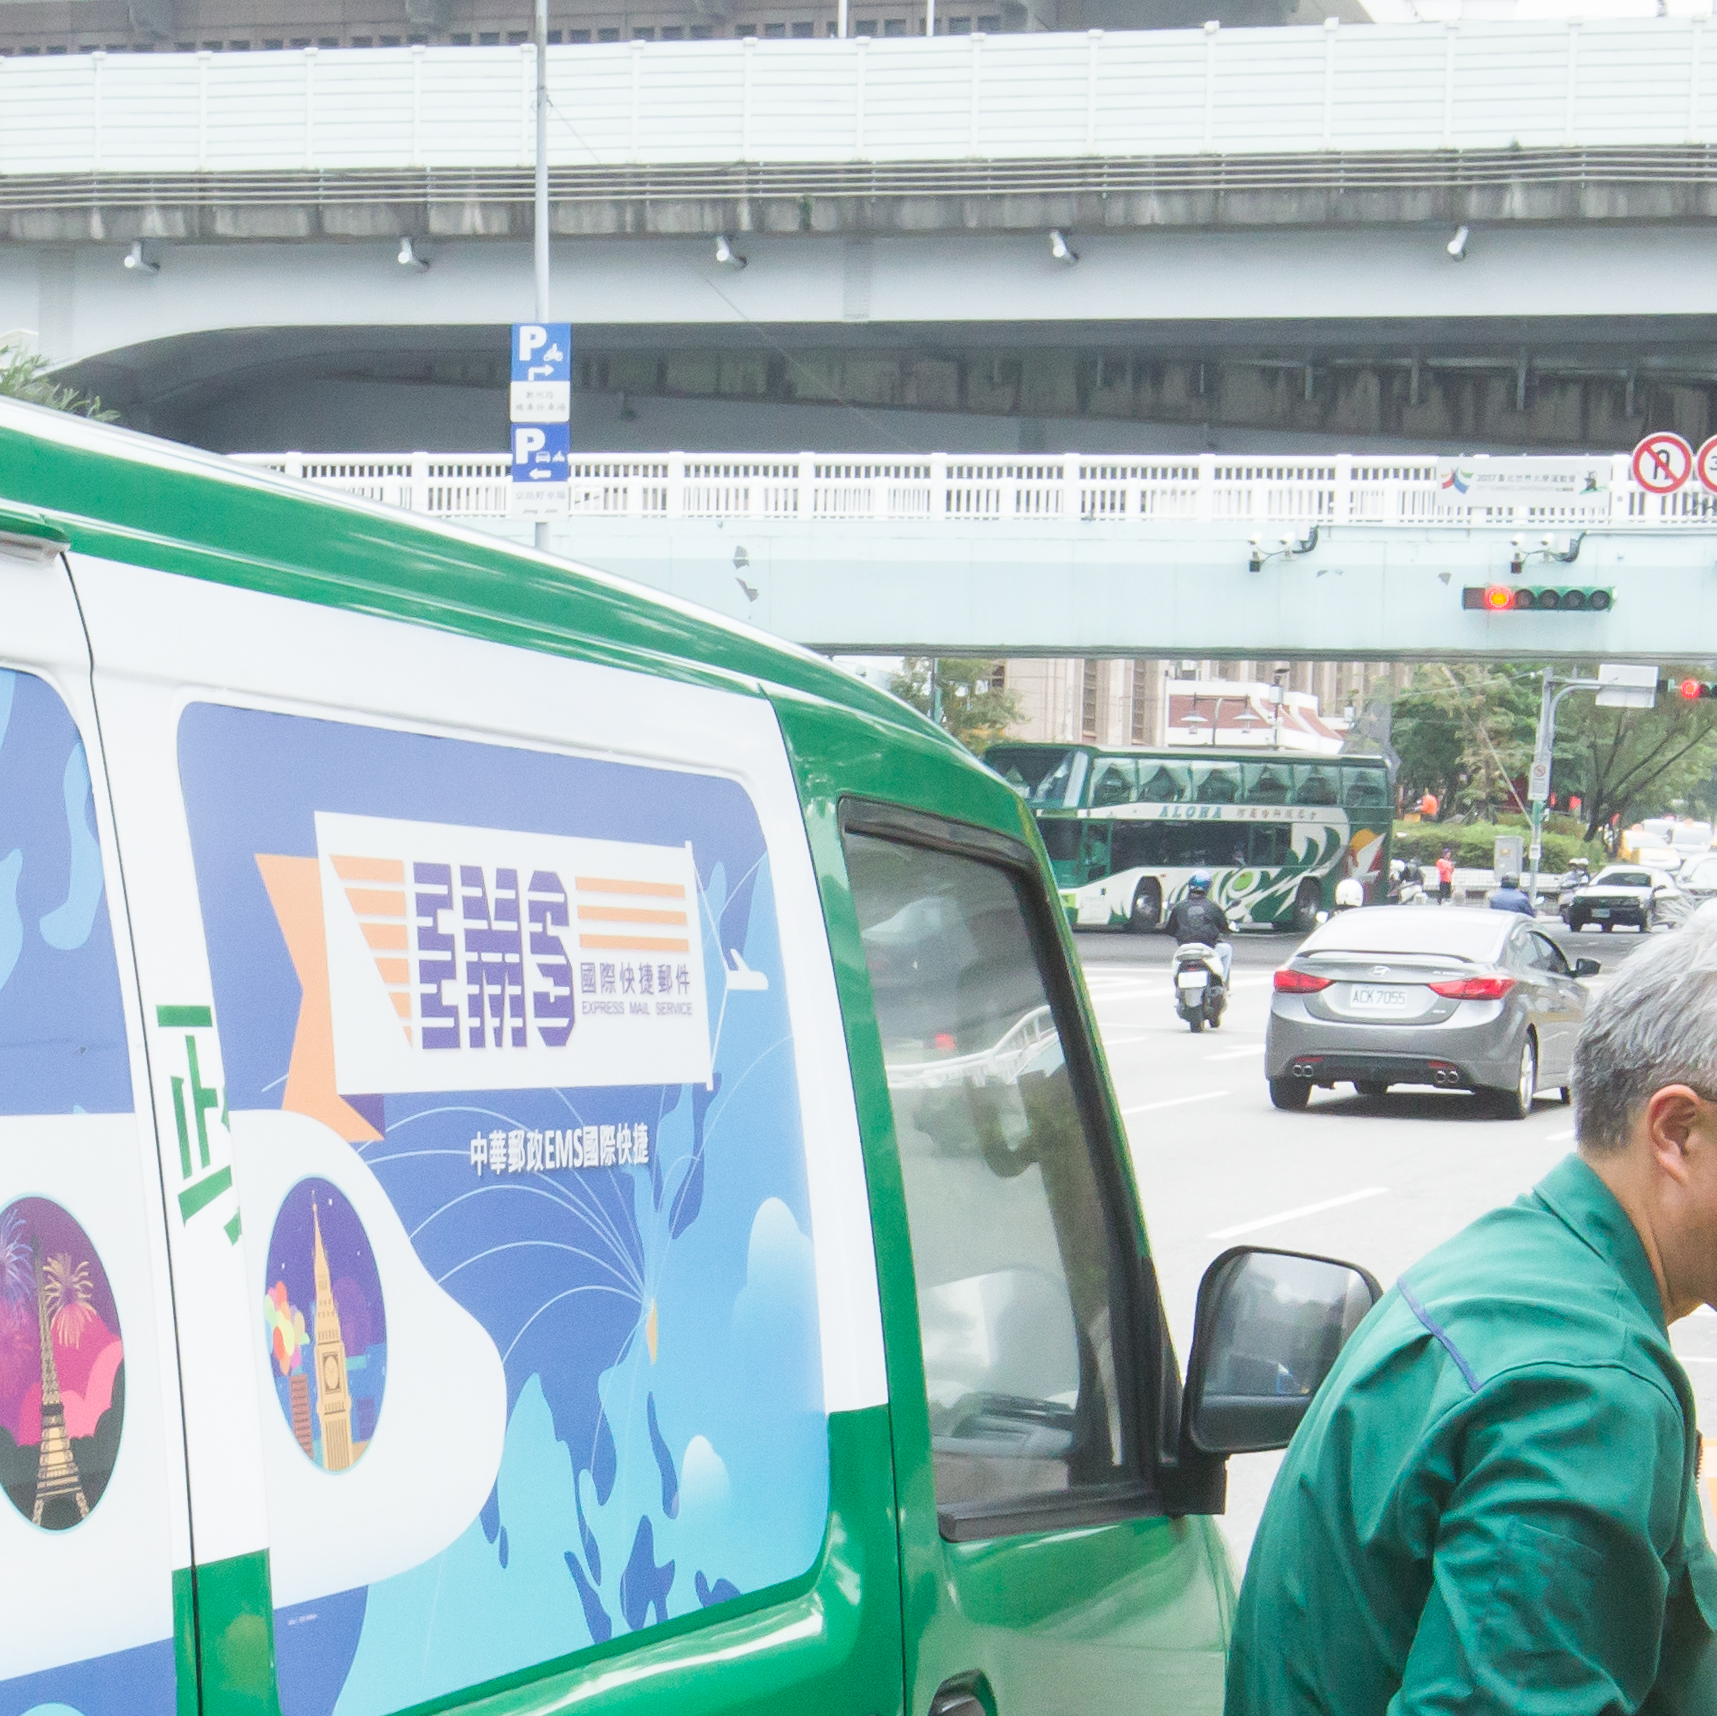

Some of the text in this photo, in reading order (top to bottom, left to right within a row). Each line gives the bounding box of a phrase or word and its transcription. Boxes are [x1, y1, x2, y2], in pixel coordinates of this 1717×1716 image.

[518, 325, 548, 361] P
[515, 427, 546, 465] P
[412, 860, 576, 1050] EMS
[580, 961, 691, 996] 國際快捷郵件
[582, 1000, 693, 1016] EXPRESS MAIL SERVICE
[469, 1122, 650, 1176] 中華郵政EMS國際快捷
